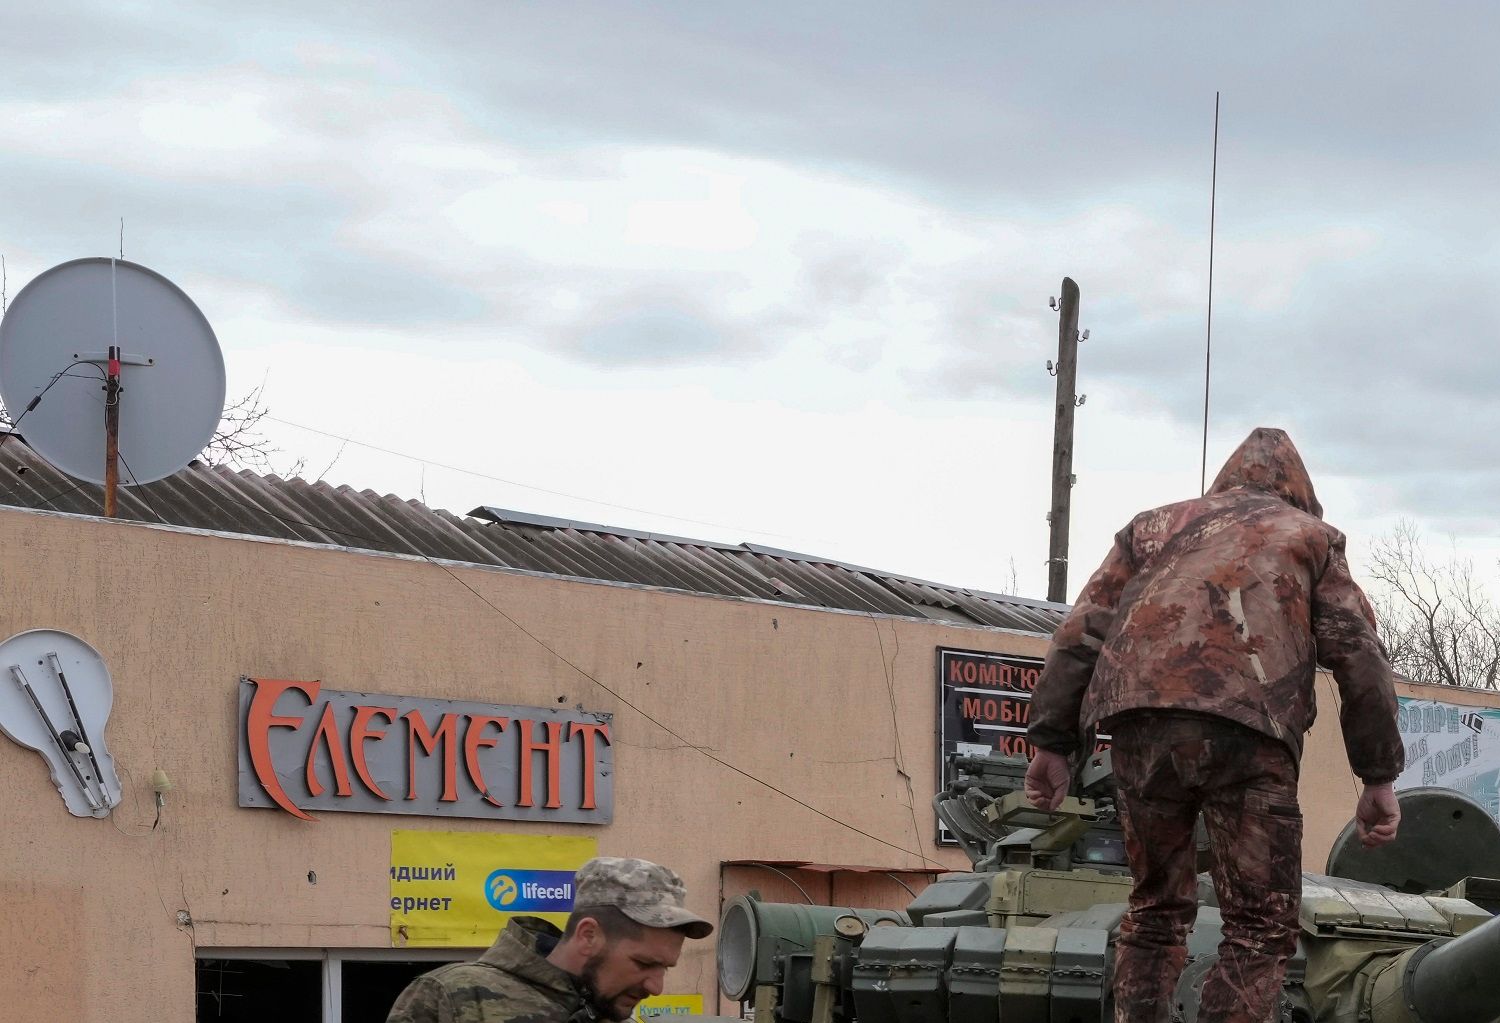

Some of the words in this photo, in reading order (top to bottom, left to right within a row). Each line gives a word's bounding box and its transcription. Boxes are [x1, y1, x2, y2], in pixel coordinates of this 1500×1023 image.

[949, 660, 1043, 688] КОМП'Ю
[1399, 704, 1460, 733] ОВАРИ
[247, 677, 612, 822] ЕЛЕМЕНТ
[391, 896, 452, 914] ернет
[522, 882, 572, 900] lifecell
